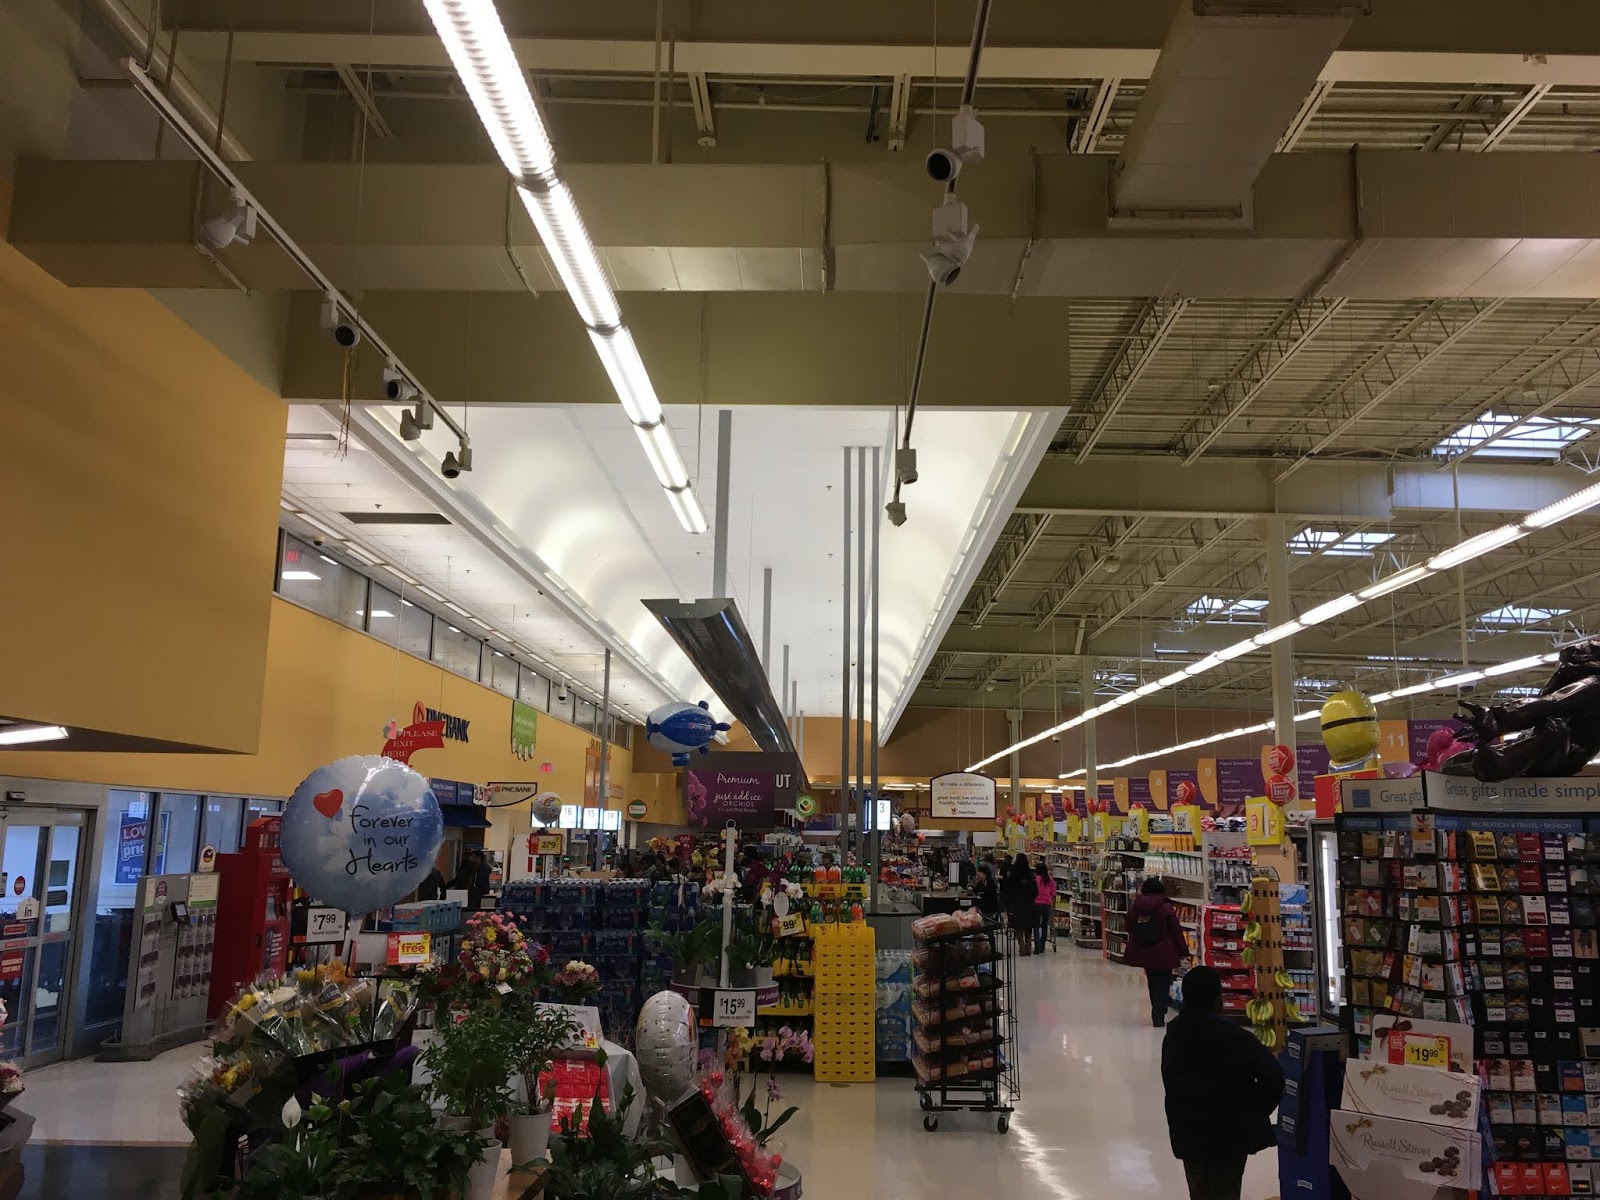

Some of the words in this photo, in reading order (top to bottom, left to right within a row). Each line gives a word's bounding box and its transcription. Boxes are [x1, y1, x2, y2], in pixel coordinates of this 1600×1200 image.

[403, 729, 438, 737] PLEASE
[1387, 733, 1405, 747] 11
[1204, 767, 1212, 777] 9
[716, 772, 760, 785] Premium
[775, 773, 791, 789] UT
[1155, 777, 1162, 786] 8
[1119, 784, 1125, 792] 7
[1273, 788, 1290, 797] buy
[1444, 780, 1469, 796] Great
[1471, 782, 1498, 801] gifts
[1503, 783, 1549, 798] made
[713, 791, 732, 804] just
[1380, 789, 1408, 803] Great
[1408, 788, 1422, 806] gifts
[564, 807, 572, 816] 16
[879, 802, 885, 813] 3
[349, 804, 414, 834] Forever
[587, 809, 595, 818] 15
[607, 811, 615, 819] 14
[1471, 820, 1510, 829] RECREATION
[1517, 821, 1539, 829] TRAVEL
[1543, 822, 1572, 830] FASHION
[363, 833, 377, 848] in
[383, 833, 411, 848] our
[123, 845, 145, 859] pric
[345, 847, 419, 875] Hearts
[24, 906, 32, 917] In
[401, 943, 426, 953] free
[1359, 1132, 1397, 1152] Russell
[1397, 1138, 1432, 1157] Stover
